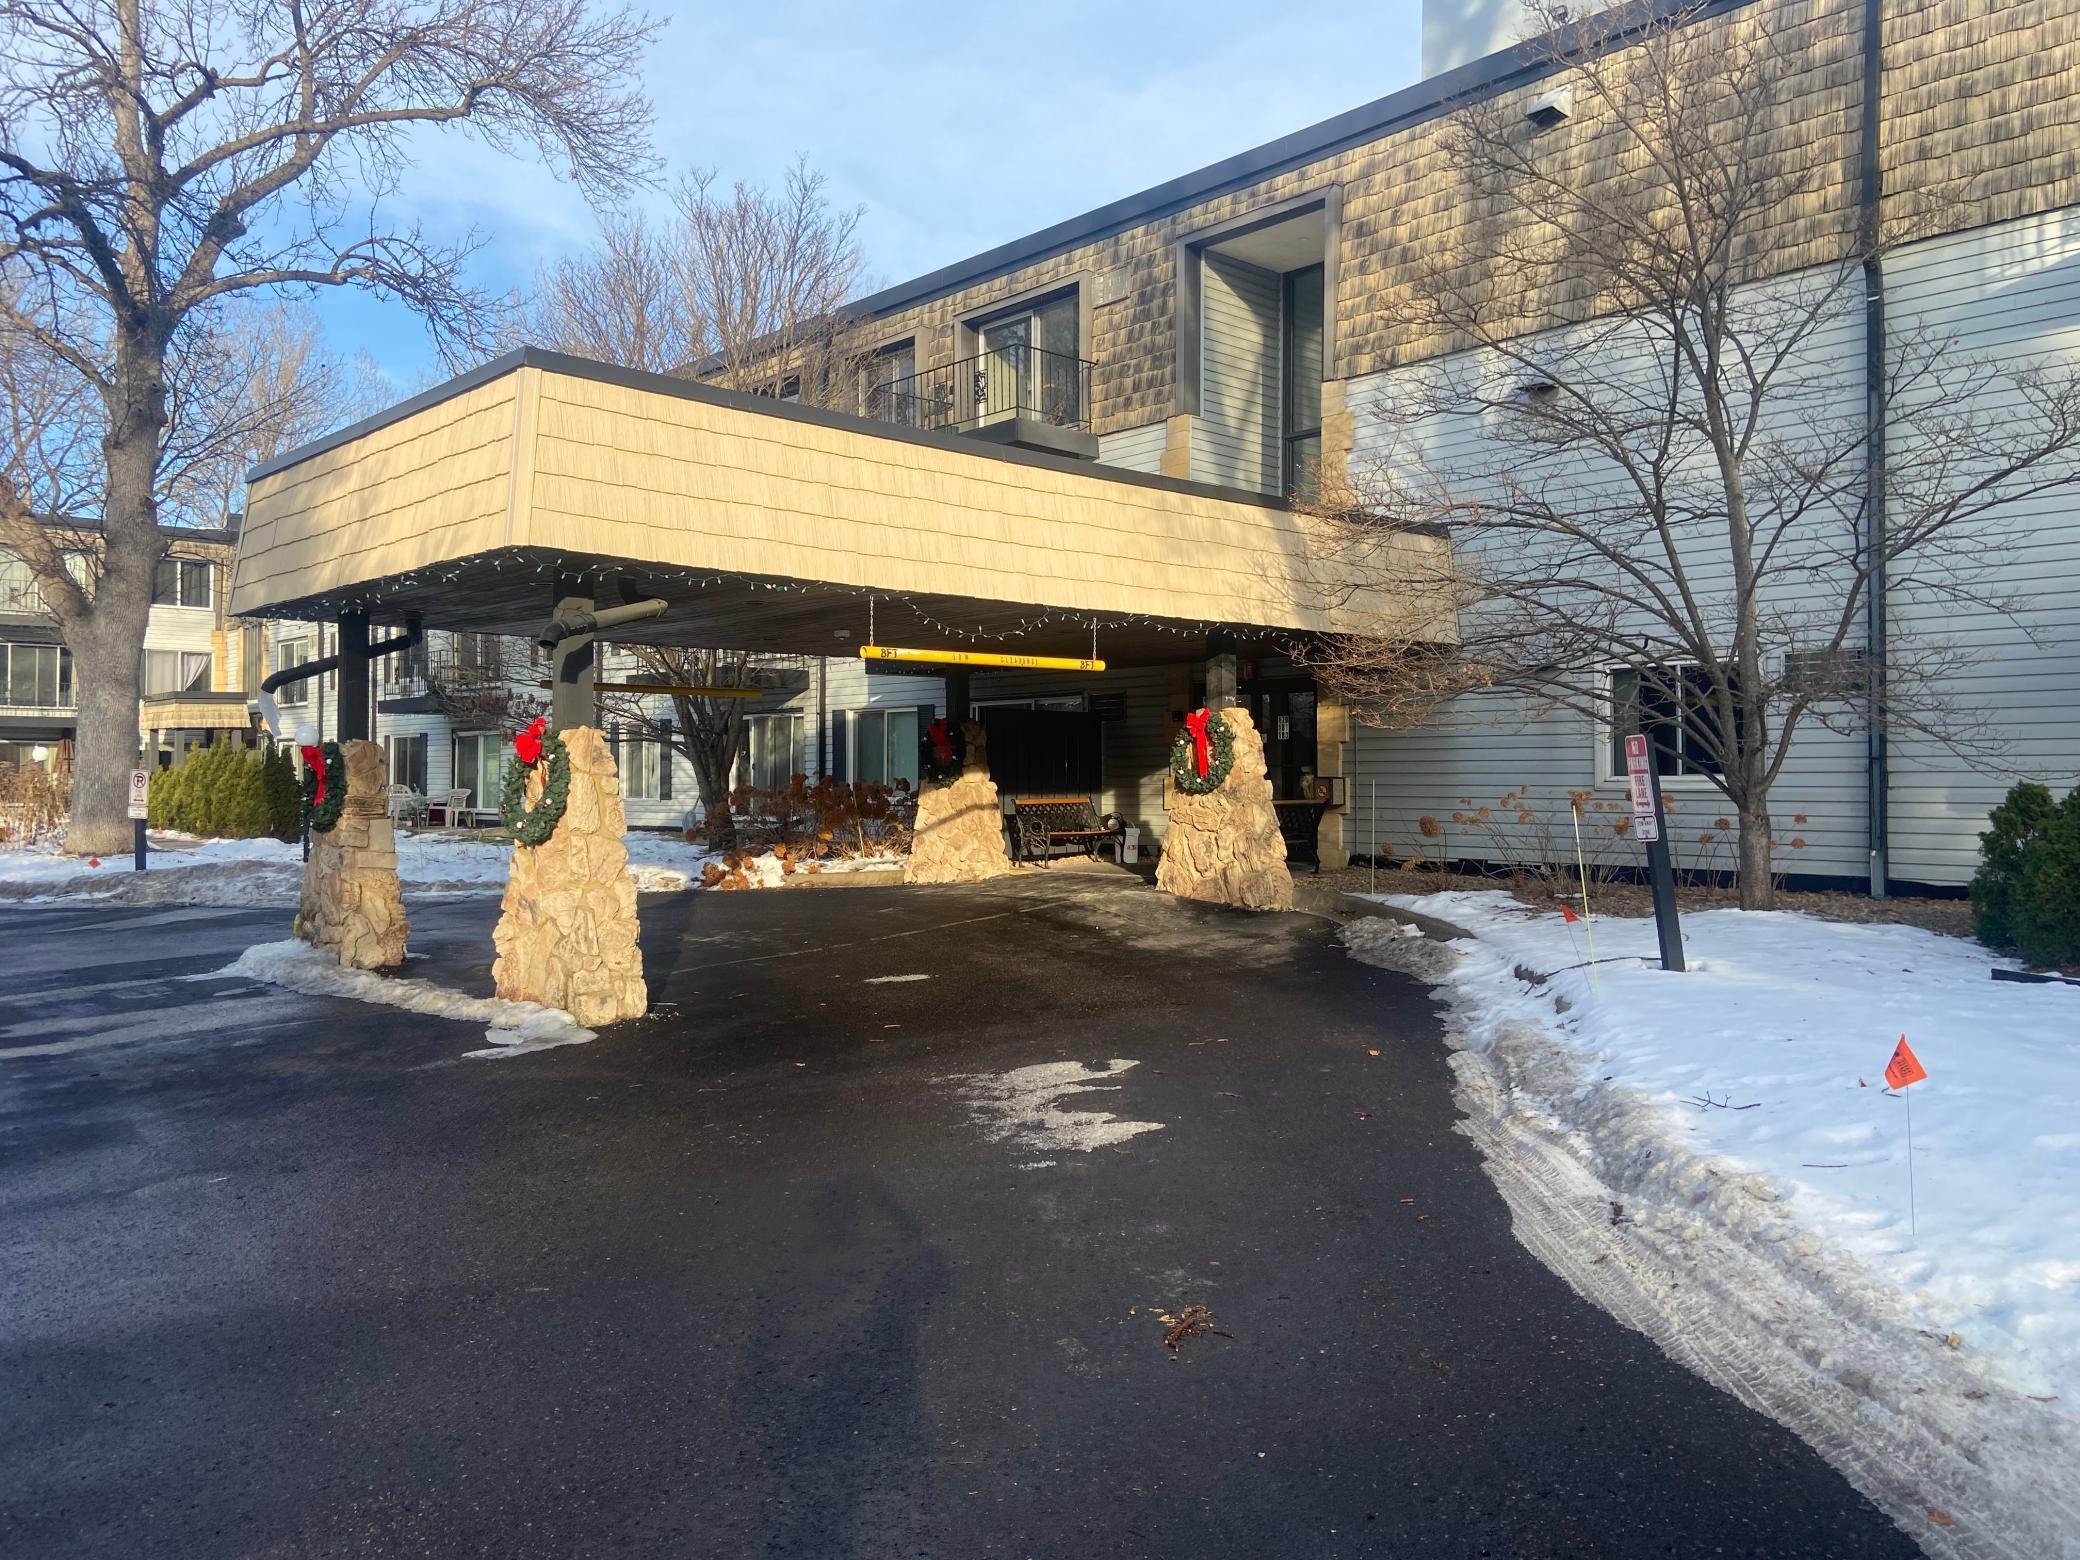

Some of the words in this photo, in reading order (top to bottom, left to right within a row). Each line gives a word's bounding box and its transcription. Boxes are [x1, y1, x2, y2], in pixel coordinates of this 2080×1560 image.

[880, 648, 899, 658] 8FT
[1080, 660, 1095, 670] 8FT
[1634, 775, 1646, 786] FIRE
[1636, 787, 1648, 799] LANE
